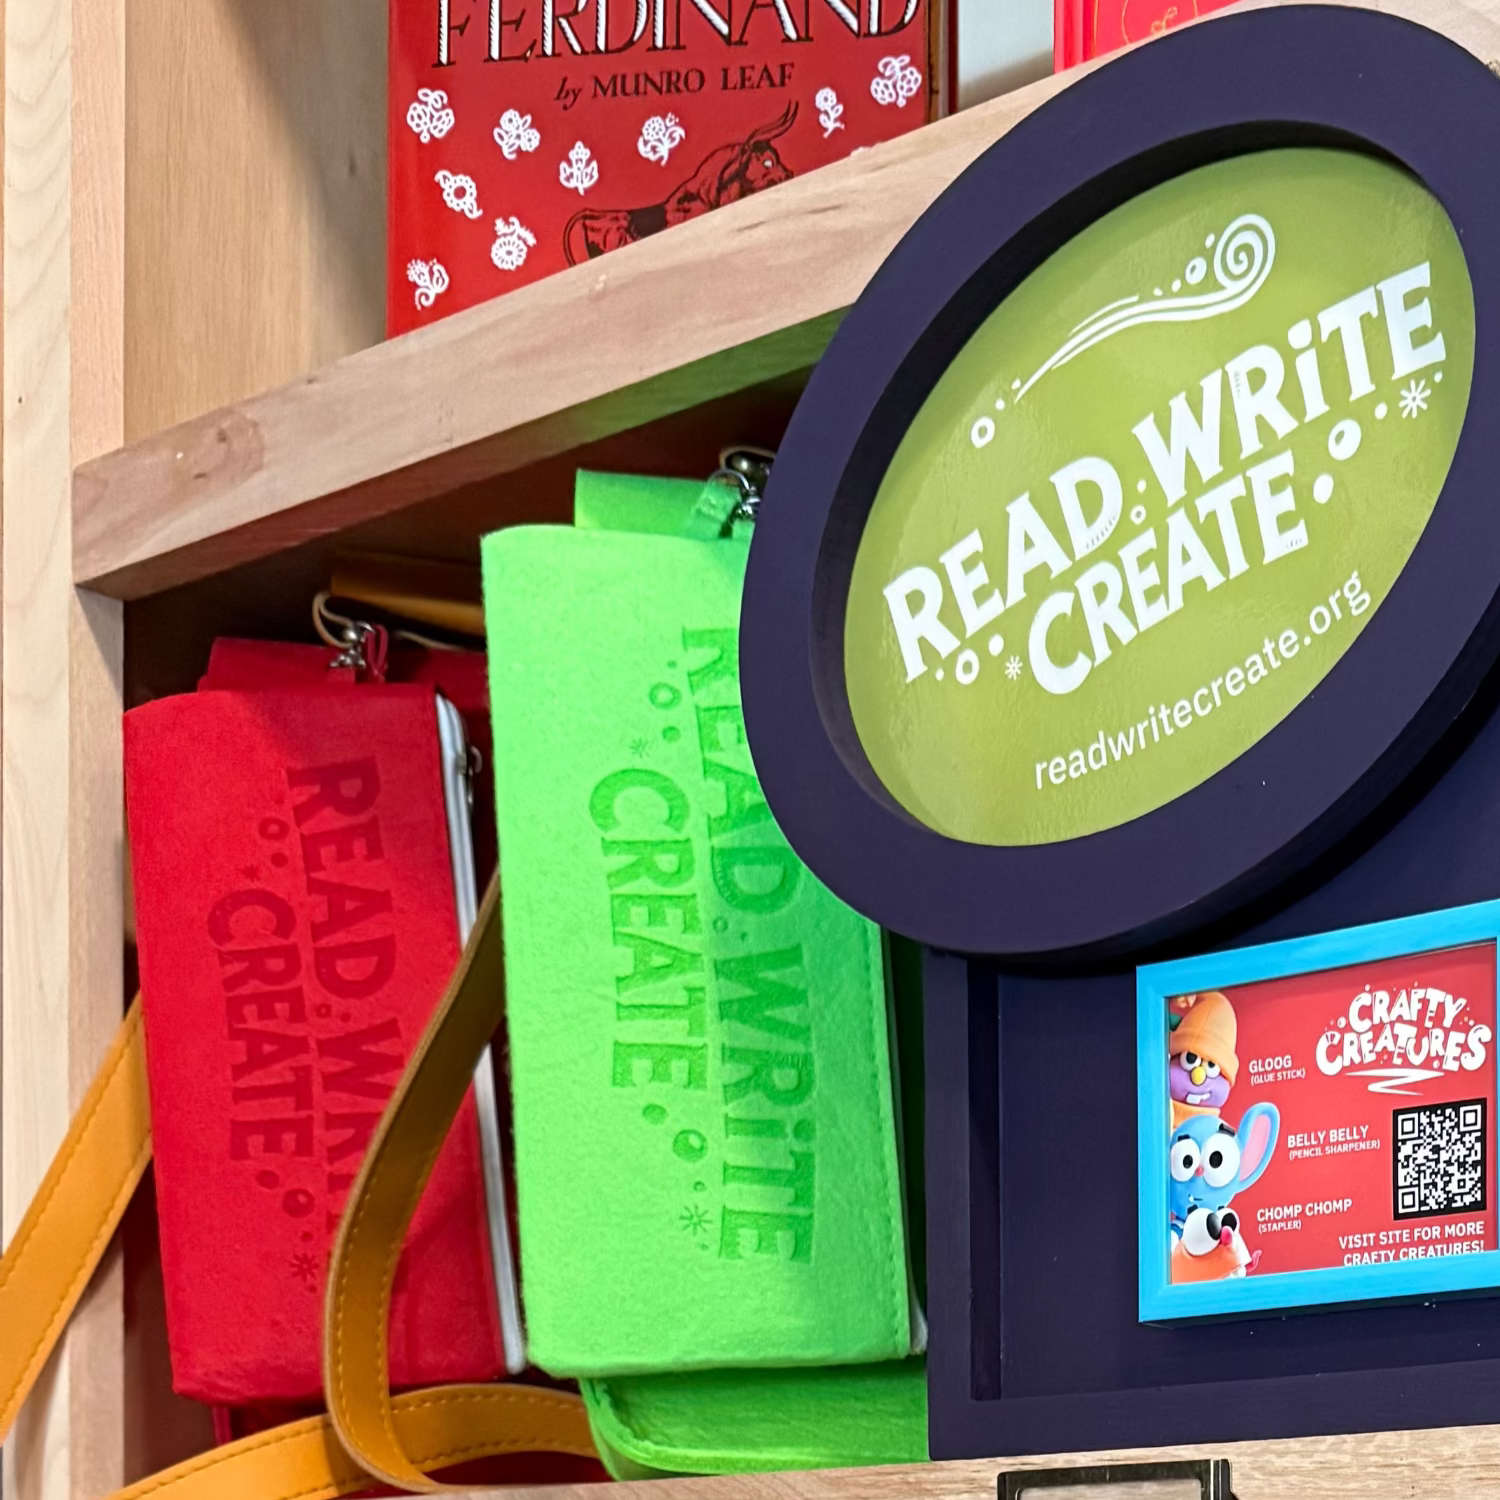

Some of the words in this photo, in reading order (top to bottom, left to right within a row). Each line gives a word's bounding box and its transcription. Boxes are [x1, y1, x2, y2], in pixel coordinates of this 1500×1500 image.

[554, 77, 583, 111] by
[591, 68, 705, 101] MUNRO
[720, 62, 795, 92] LEAF
[882, 454, 1124, 684] READ
[1027, 449, 1310, 695] CREATE
[1033, 569, 1373, 791] readwritecreate.org
[286, 757, 397, 1000] READ
[589, 767, 711, 1094] CREATE
[207, 889, 319, 1167] CREATE
[1348, 987, 1467, 1033] CRAFTY
[1248, 1055, 1292, 1074] GLOOG
[1315, 1022, 1493, 1076] CREATURES
[1250, 1072, 1275, 1087] (GLUE
[1276, 1067, 1306, 1082] STICK)
[1287, 1131, 1326, 1149] BELLY
[1329, 1125, 1369, 1142] BELLY
[1289, 1147, 1323, 1161] (PENCIL
[1325, 1139, 1381, 1156] SHARPENER)
[1256, 1204, 1302, 1222] CHOMP
[1305, 1198, 1352, 1217] CHOMP
[1258, 1219, 1302, 1235] (STAPLER)
[1338, 1232, 1376, 1250] VISIT
[1379, 1229, 1410, 1245] SITE
[1413, 1225, 1441, 1242] FOR
[1444, 1221, 1485, 1238] MORE
[1343, 1249, 1395, 1267] CRAFTY
[1399, 1239, 1485, 1262] CREATURES!
